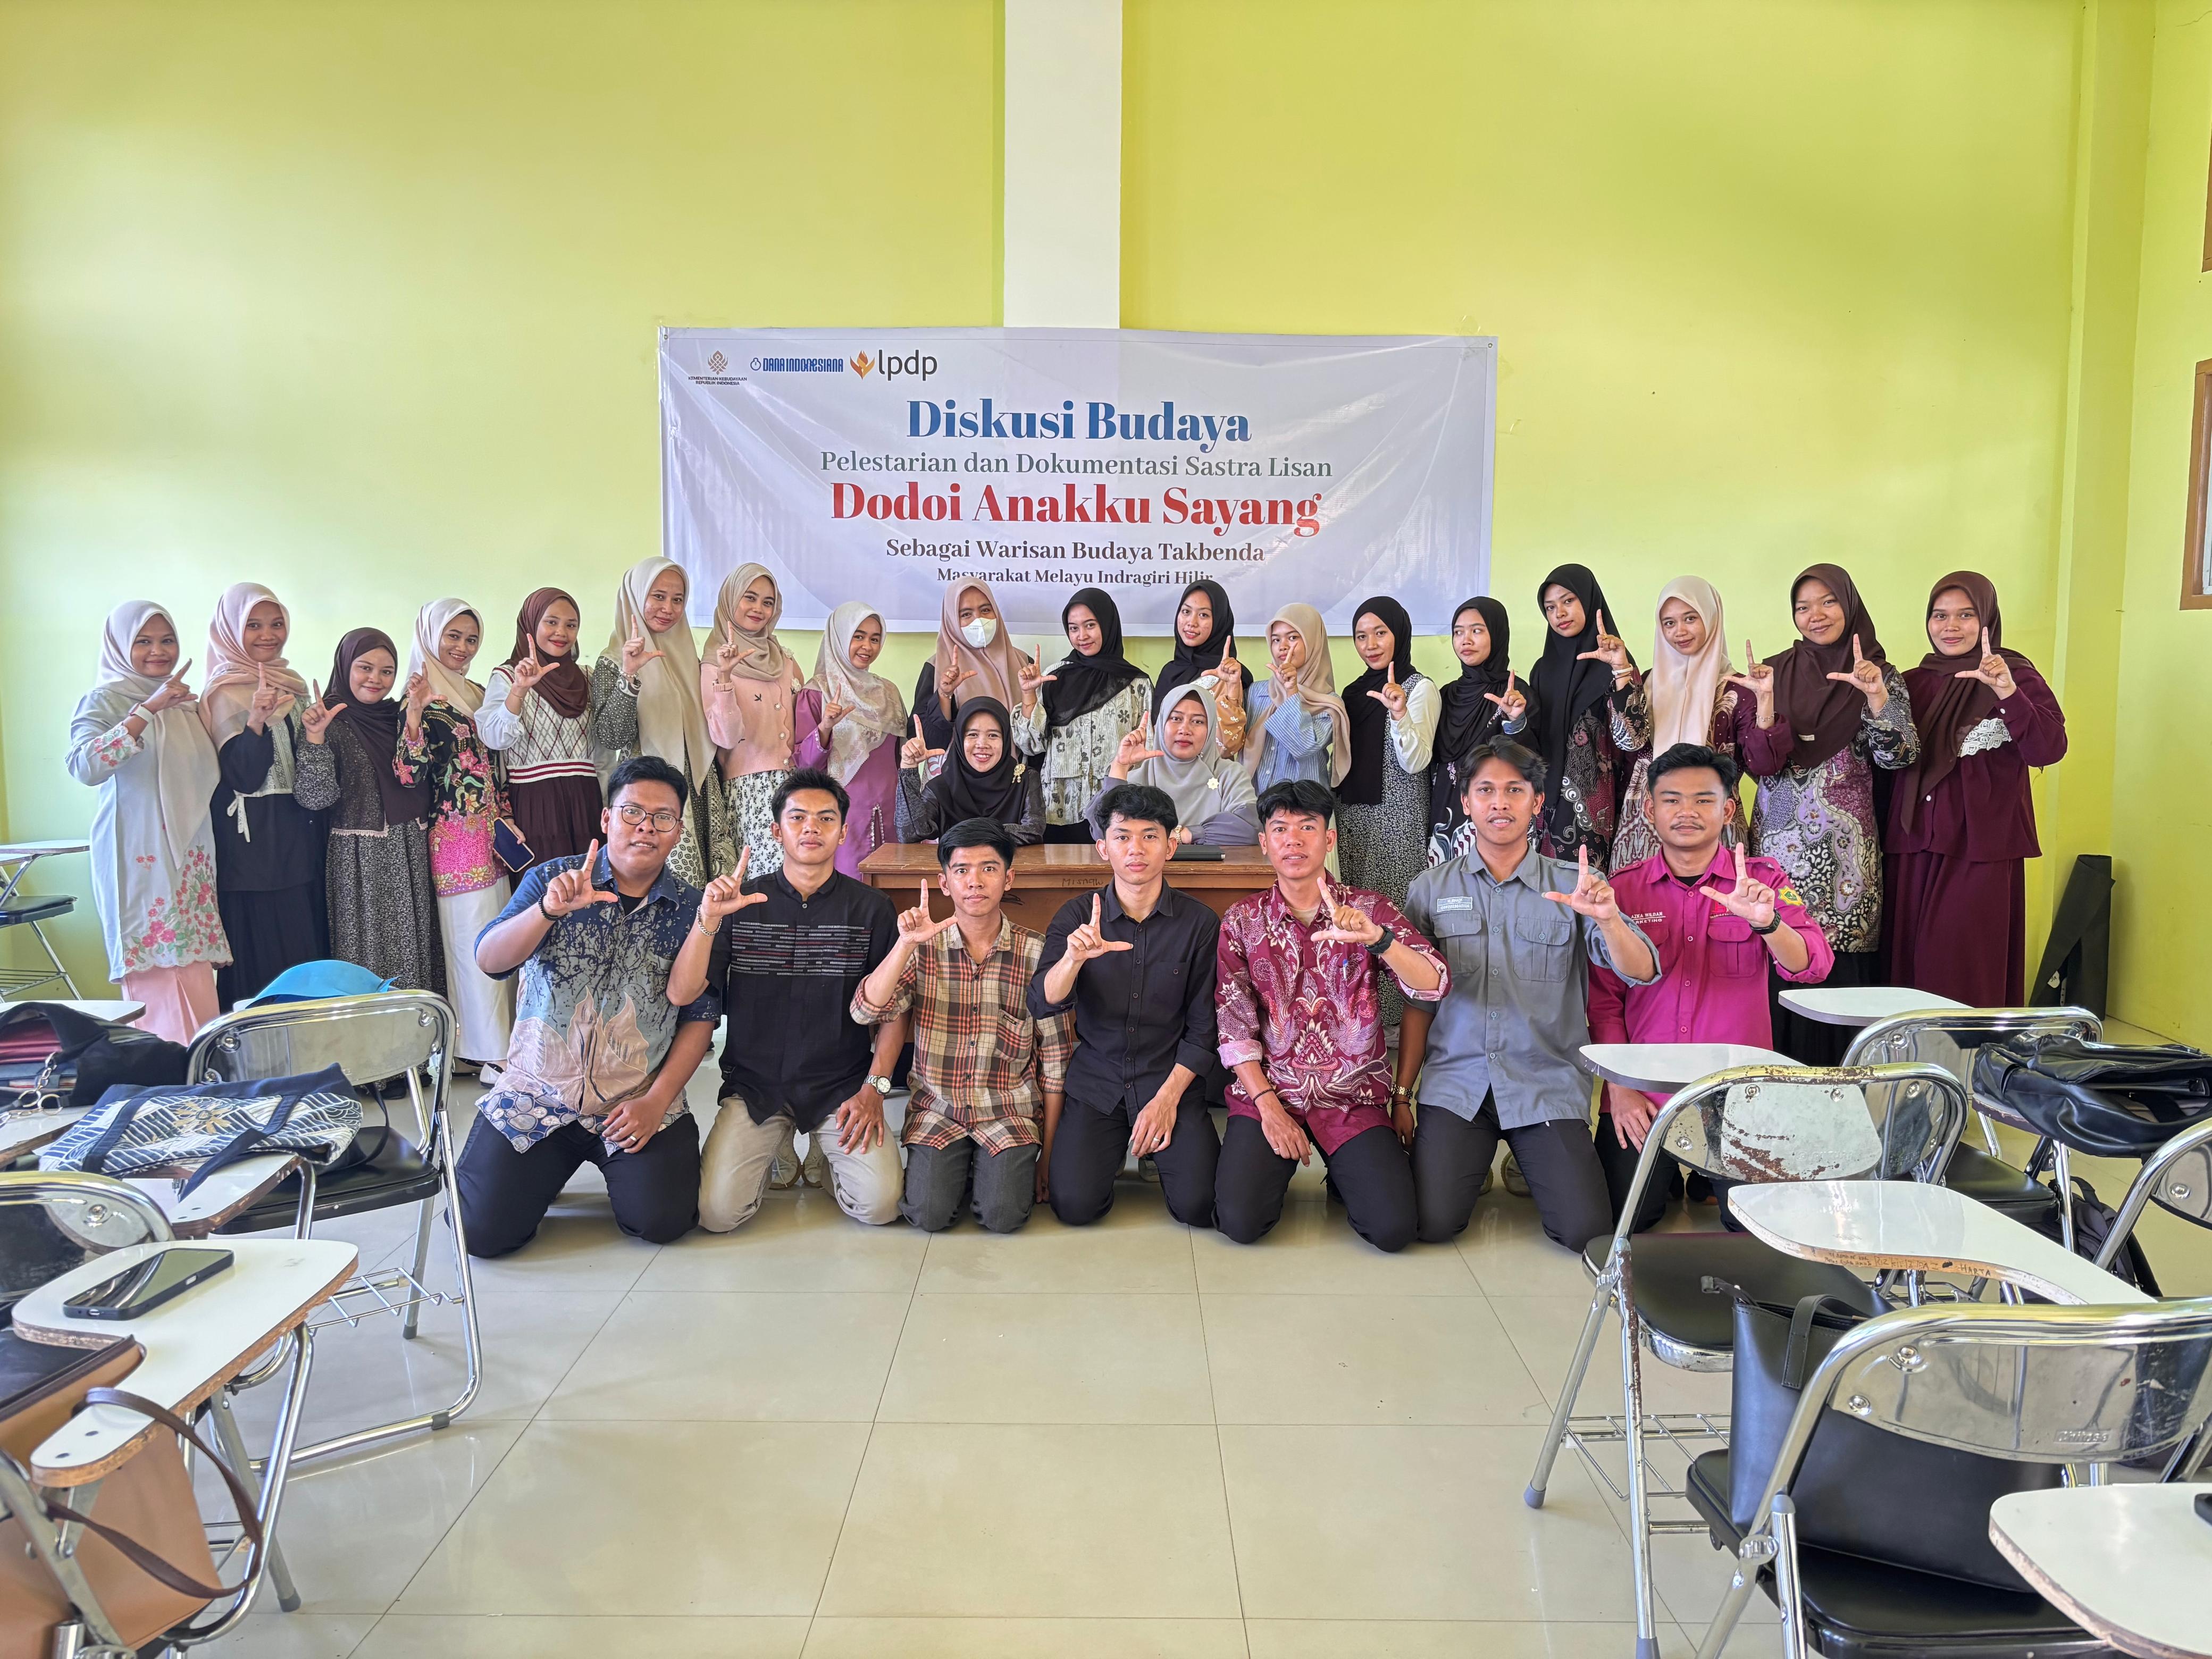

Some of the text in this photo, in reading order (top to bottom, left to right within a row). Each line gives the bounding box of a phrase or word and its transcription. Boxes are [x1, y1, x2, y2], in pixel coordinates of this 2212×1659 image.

[763, 357, 785, 372] DANA
[878, 349, 937, 381] lpdp
[907, 398, 1252, 453] Diskusi Budaya
[820, 450, 1333, 477] Pelestarian dan Dokumentasi Sastra Lisan
[830, 481, 1322, 538] Dodoi Anakku Sayang
[886, 538, 1265, 565] Sebagai Warisan Budaya Takbenda
[1034, 569, 1093, 586] Melayu
[1097, 569, 1170, 588] Indragiri
